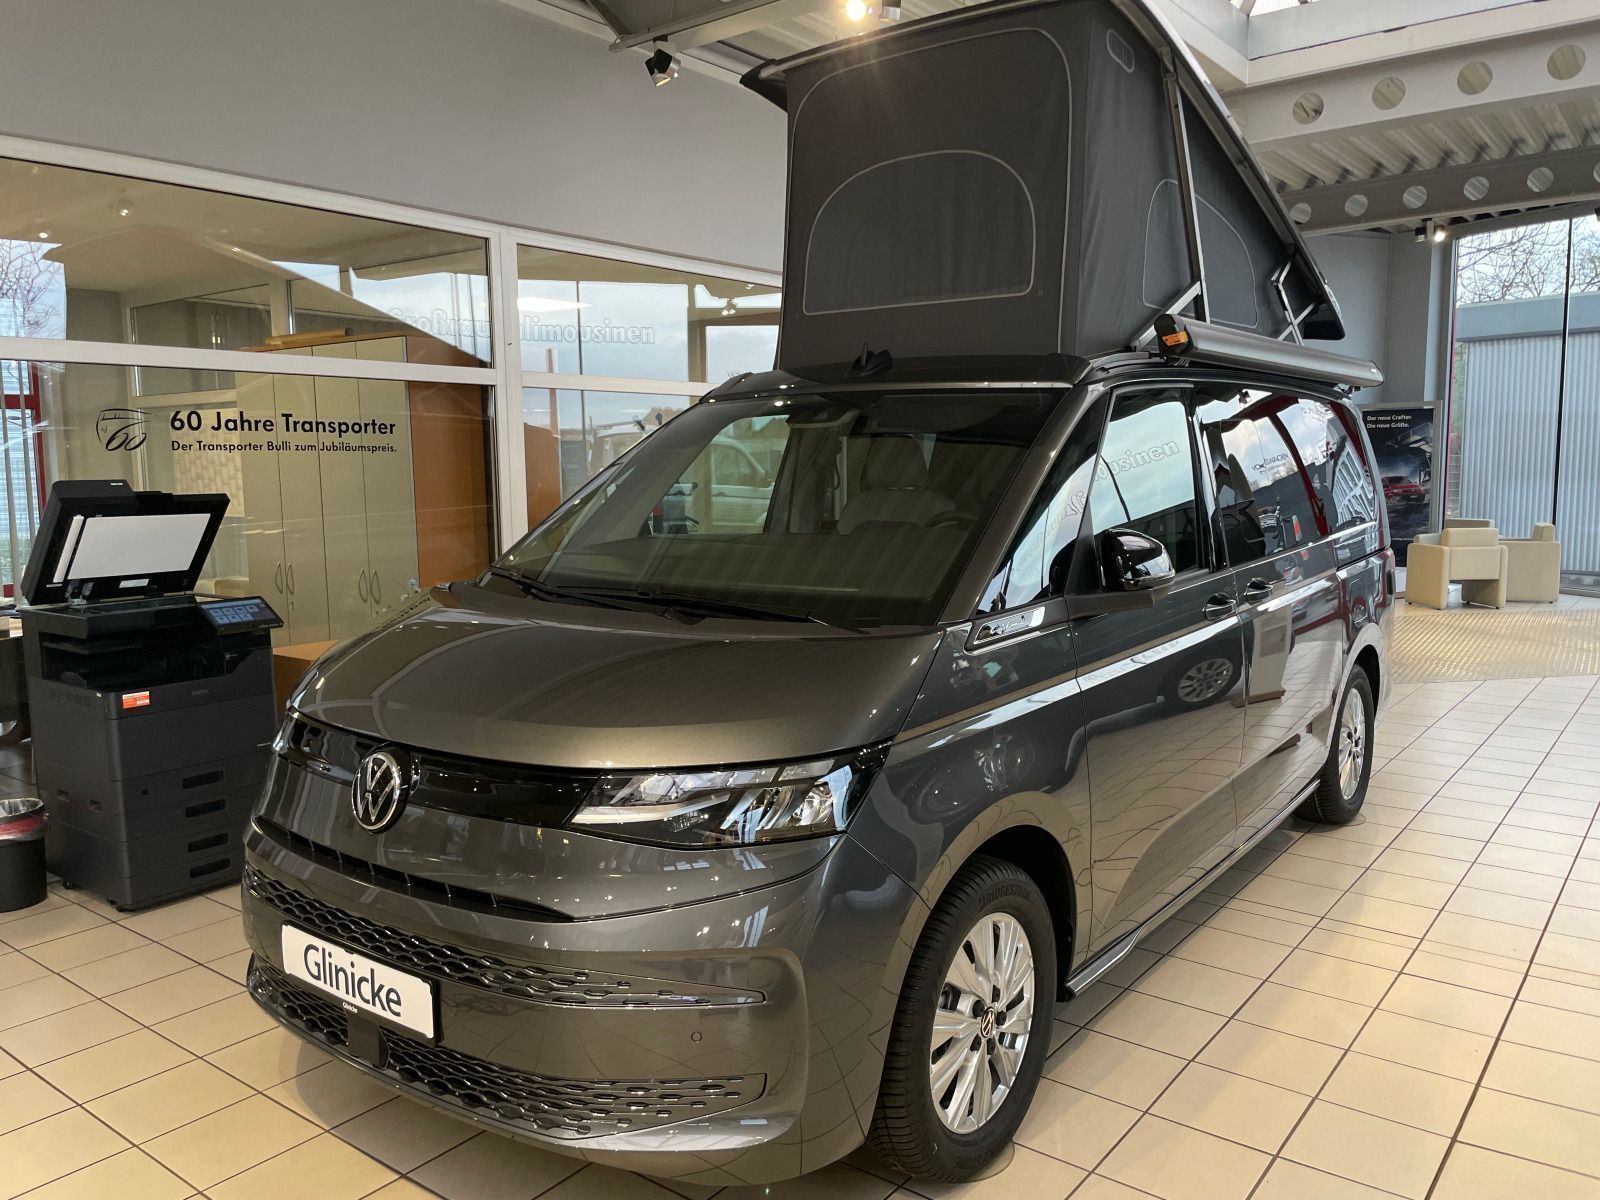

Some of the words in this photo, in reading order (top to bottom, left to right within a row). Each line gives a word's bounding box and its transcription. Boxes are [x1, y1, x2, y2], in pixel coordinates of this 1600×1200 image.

[170, 410, 202, 431] 60
[211, 411, 275, 432] Jahre
[281, 413, 396, 438] Transporter
[171, 440, 193, 451] Der
[196, 440, 264, 453] Transporter
[266, 441, 291, 451] Bulli
[294, 444, 317, 452] zum
[319, 441, 397, 454] Jubiläumspreis.
[303, 943, 402, 1018] Glinicke
